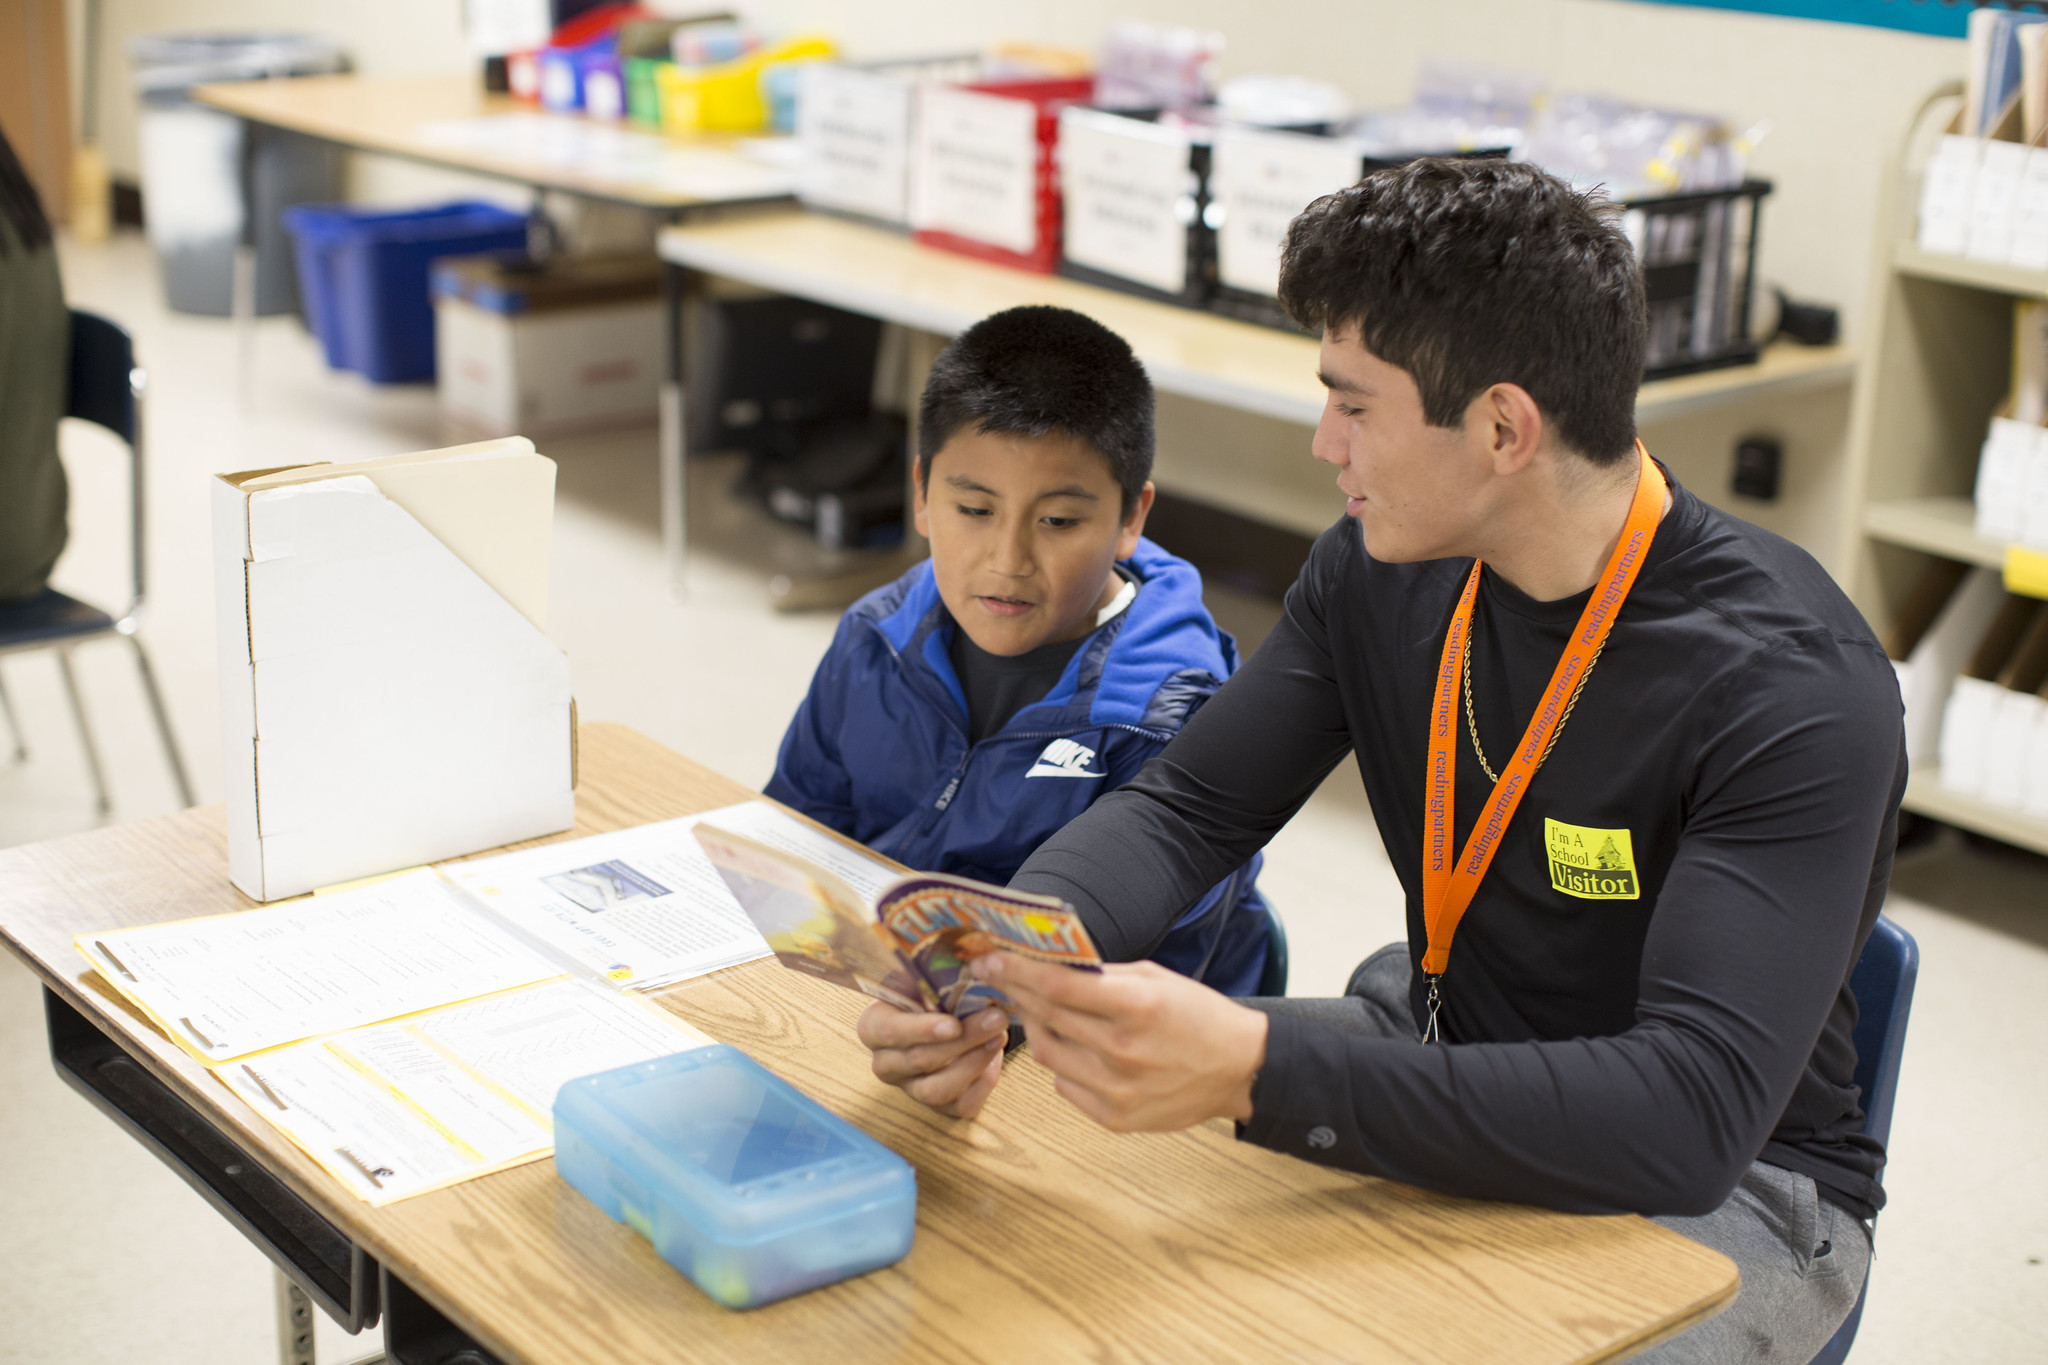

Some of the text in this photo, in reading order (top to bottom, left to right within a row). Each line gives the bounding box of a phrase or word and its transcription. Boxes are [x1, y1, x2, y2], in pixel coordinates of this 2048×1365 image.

[1580, 529, 1644, 646] readingpartners
[1437, 617, 1463, 737] readingpartners
[1521, 654, 1581, 765] readingpartners
[1038, 738, 1096, 772] NIKE
[1430, 750, 1450, 871] readingpartners
[1466, 773, 1522, 875] readingpartners
[1551, 827, 1584, 847] I'm A
[1550, 844, 1589, 866] School
[1554, 862, 1629, 894] Visitor
[891, 897, 964, 944] FLAT
